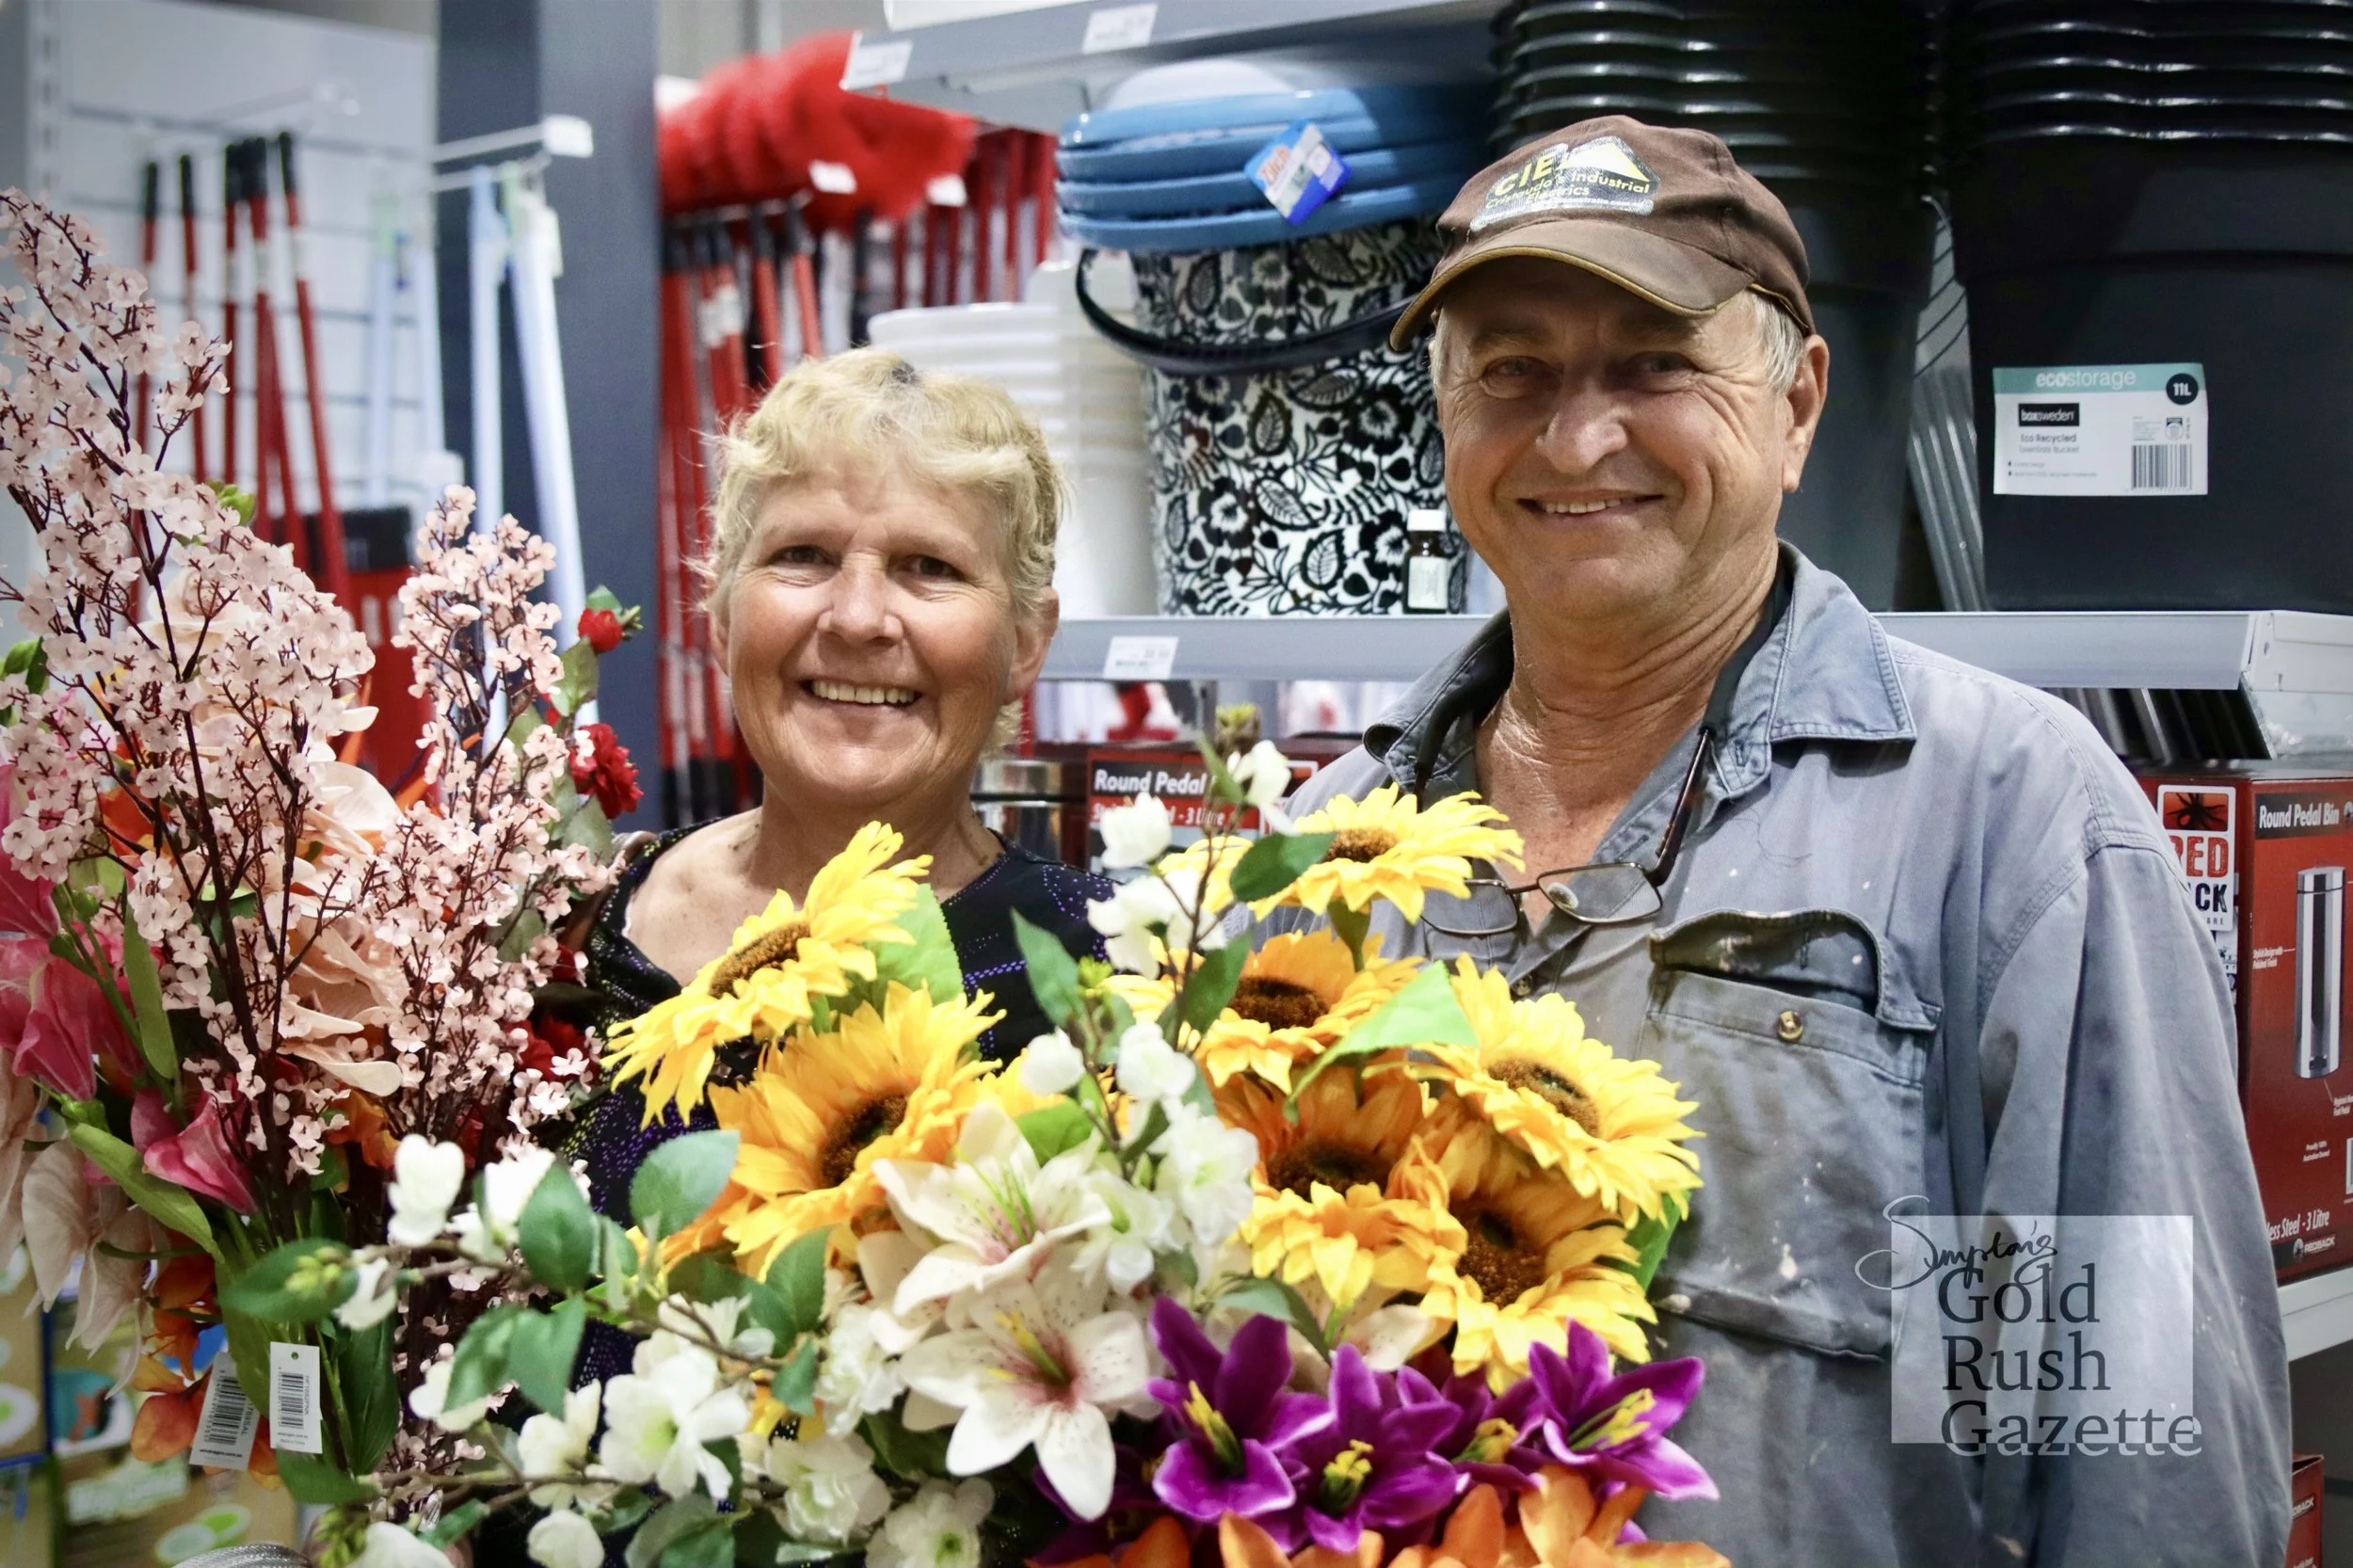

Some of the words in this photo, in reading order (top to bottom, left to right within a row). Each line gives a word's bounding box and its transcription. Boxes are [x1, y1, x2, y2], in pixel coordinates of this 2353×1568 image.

[1495, 152, 1555, 197] CIE
[1571, 169, 1650, 194] Industrial
[2036, 370, 2137, 390] ecostorage
[2173, 382, 2191, 396] 11L
[1095, 769, 1151, 792] Round
[1155, 771, 1207, 794] Pedal
[1186, 807, 1196, 824] 3
[2259, 803, 2292, 828] Round
[2294, 803, 2322, 826] Pedal
[2323, 802, 2340, 825] Bin
[2281, 1213, 2301, 1238] Steel
[2306, 1211, 2313, 1231] 3
[2313, 1208, 2329, 1229] Litre
[2304, 1235, 2335, 1253] REDBACK
